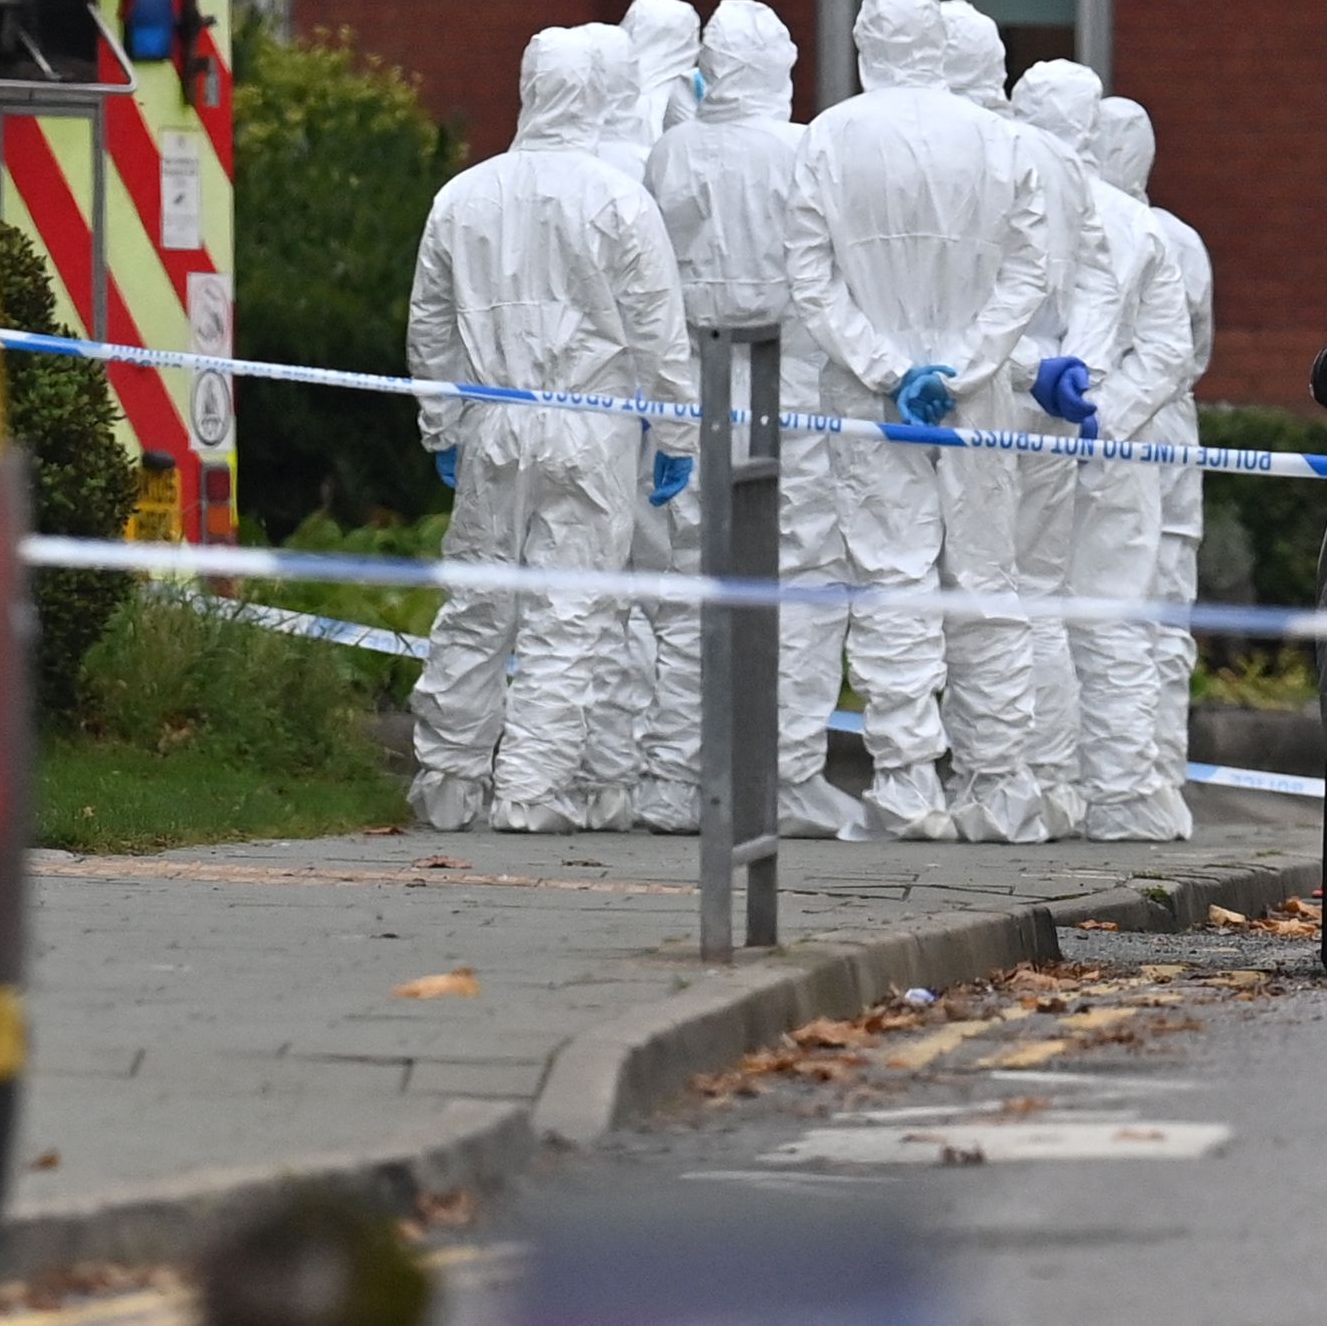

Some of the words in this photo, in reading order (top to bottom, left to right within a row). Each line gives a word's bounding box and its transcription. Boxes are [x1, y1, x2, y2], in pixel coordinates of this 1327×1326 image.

[779, 411, 842, 432] POLIC
[972, 429, 1044, 452] CROSS
[1050, 436, 1095, 456] NOT
[1102, 439, 1133, 460] DO
[1196, 446, 1273, 471] POLICE
